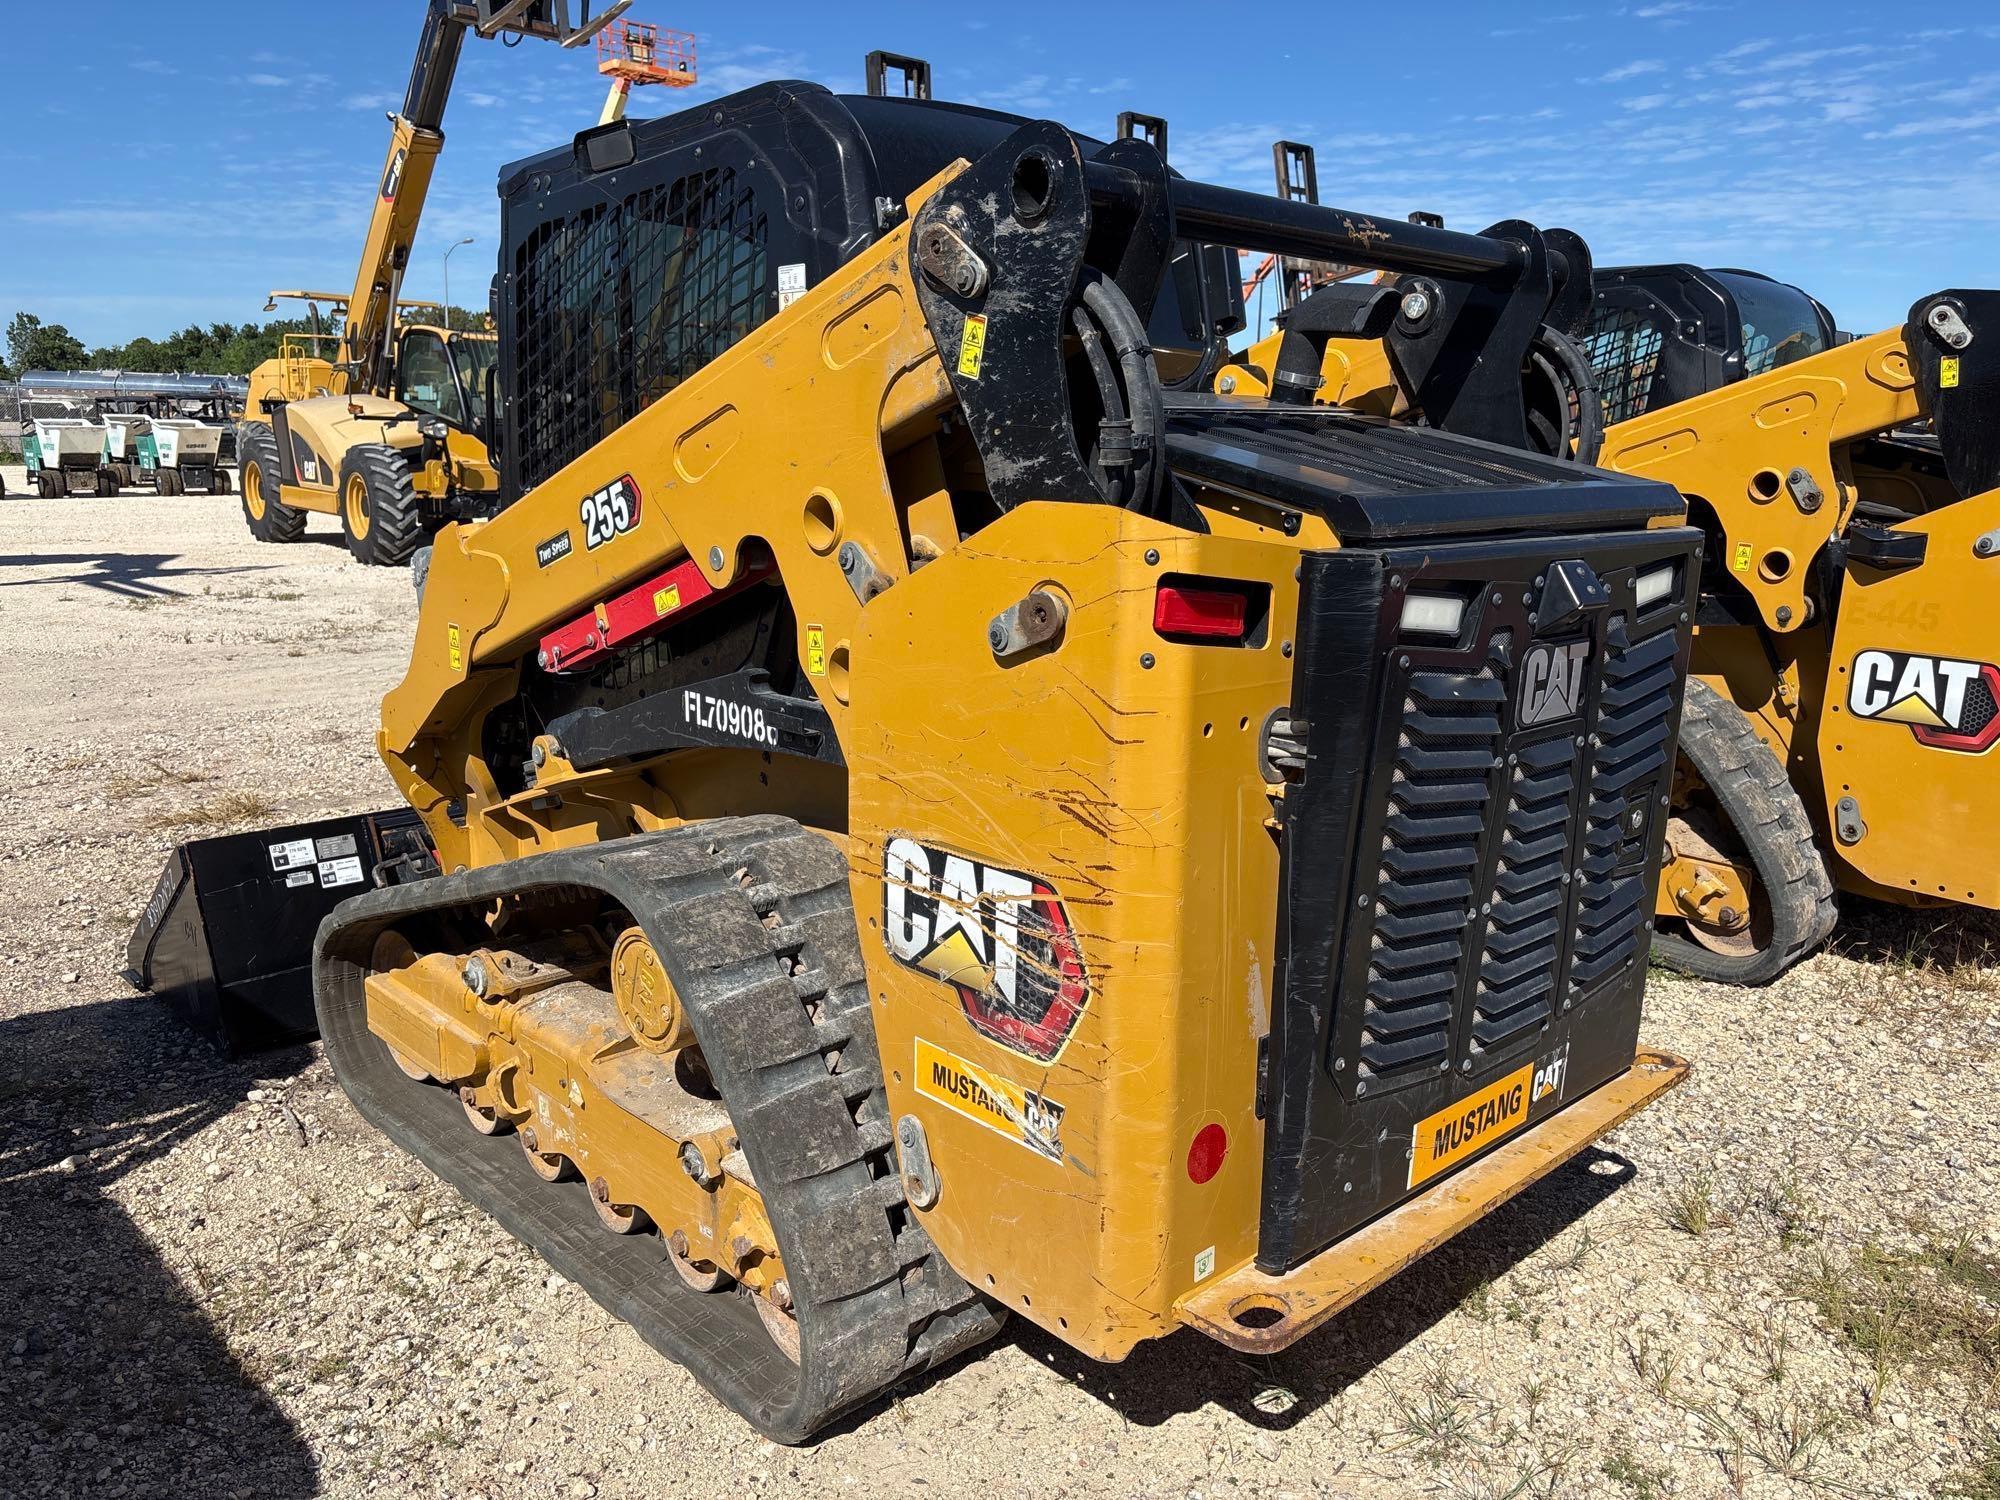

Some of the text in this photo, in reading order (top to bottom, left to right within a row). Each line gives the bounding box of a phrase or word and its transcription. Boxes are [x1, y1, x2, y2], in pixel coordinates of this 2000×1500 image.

[304, 460, 316, 480] CAT
[581, 481, 629, 547] 255
[1845, 595, 1940, 632] E-445
[1521, 641, 1590, 725] CAT
[1850, 650, 1981, 730] CAT
[884, 836, 1034, 1006] CAT
[932, 1061, 1016, 1123] MUSTANG
[1432, 1059, 1563, 1161] MUSTANG CAT
